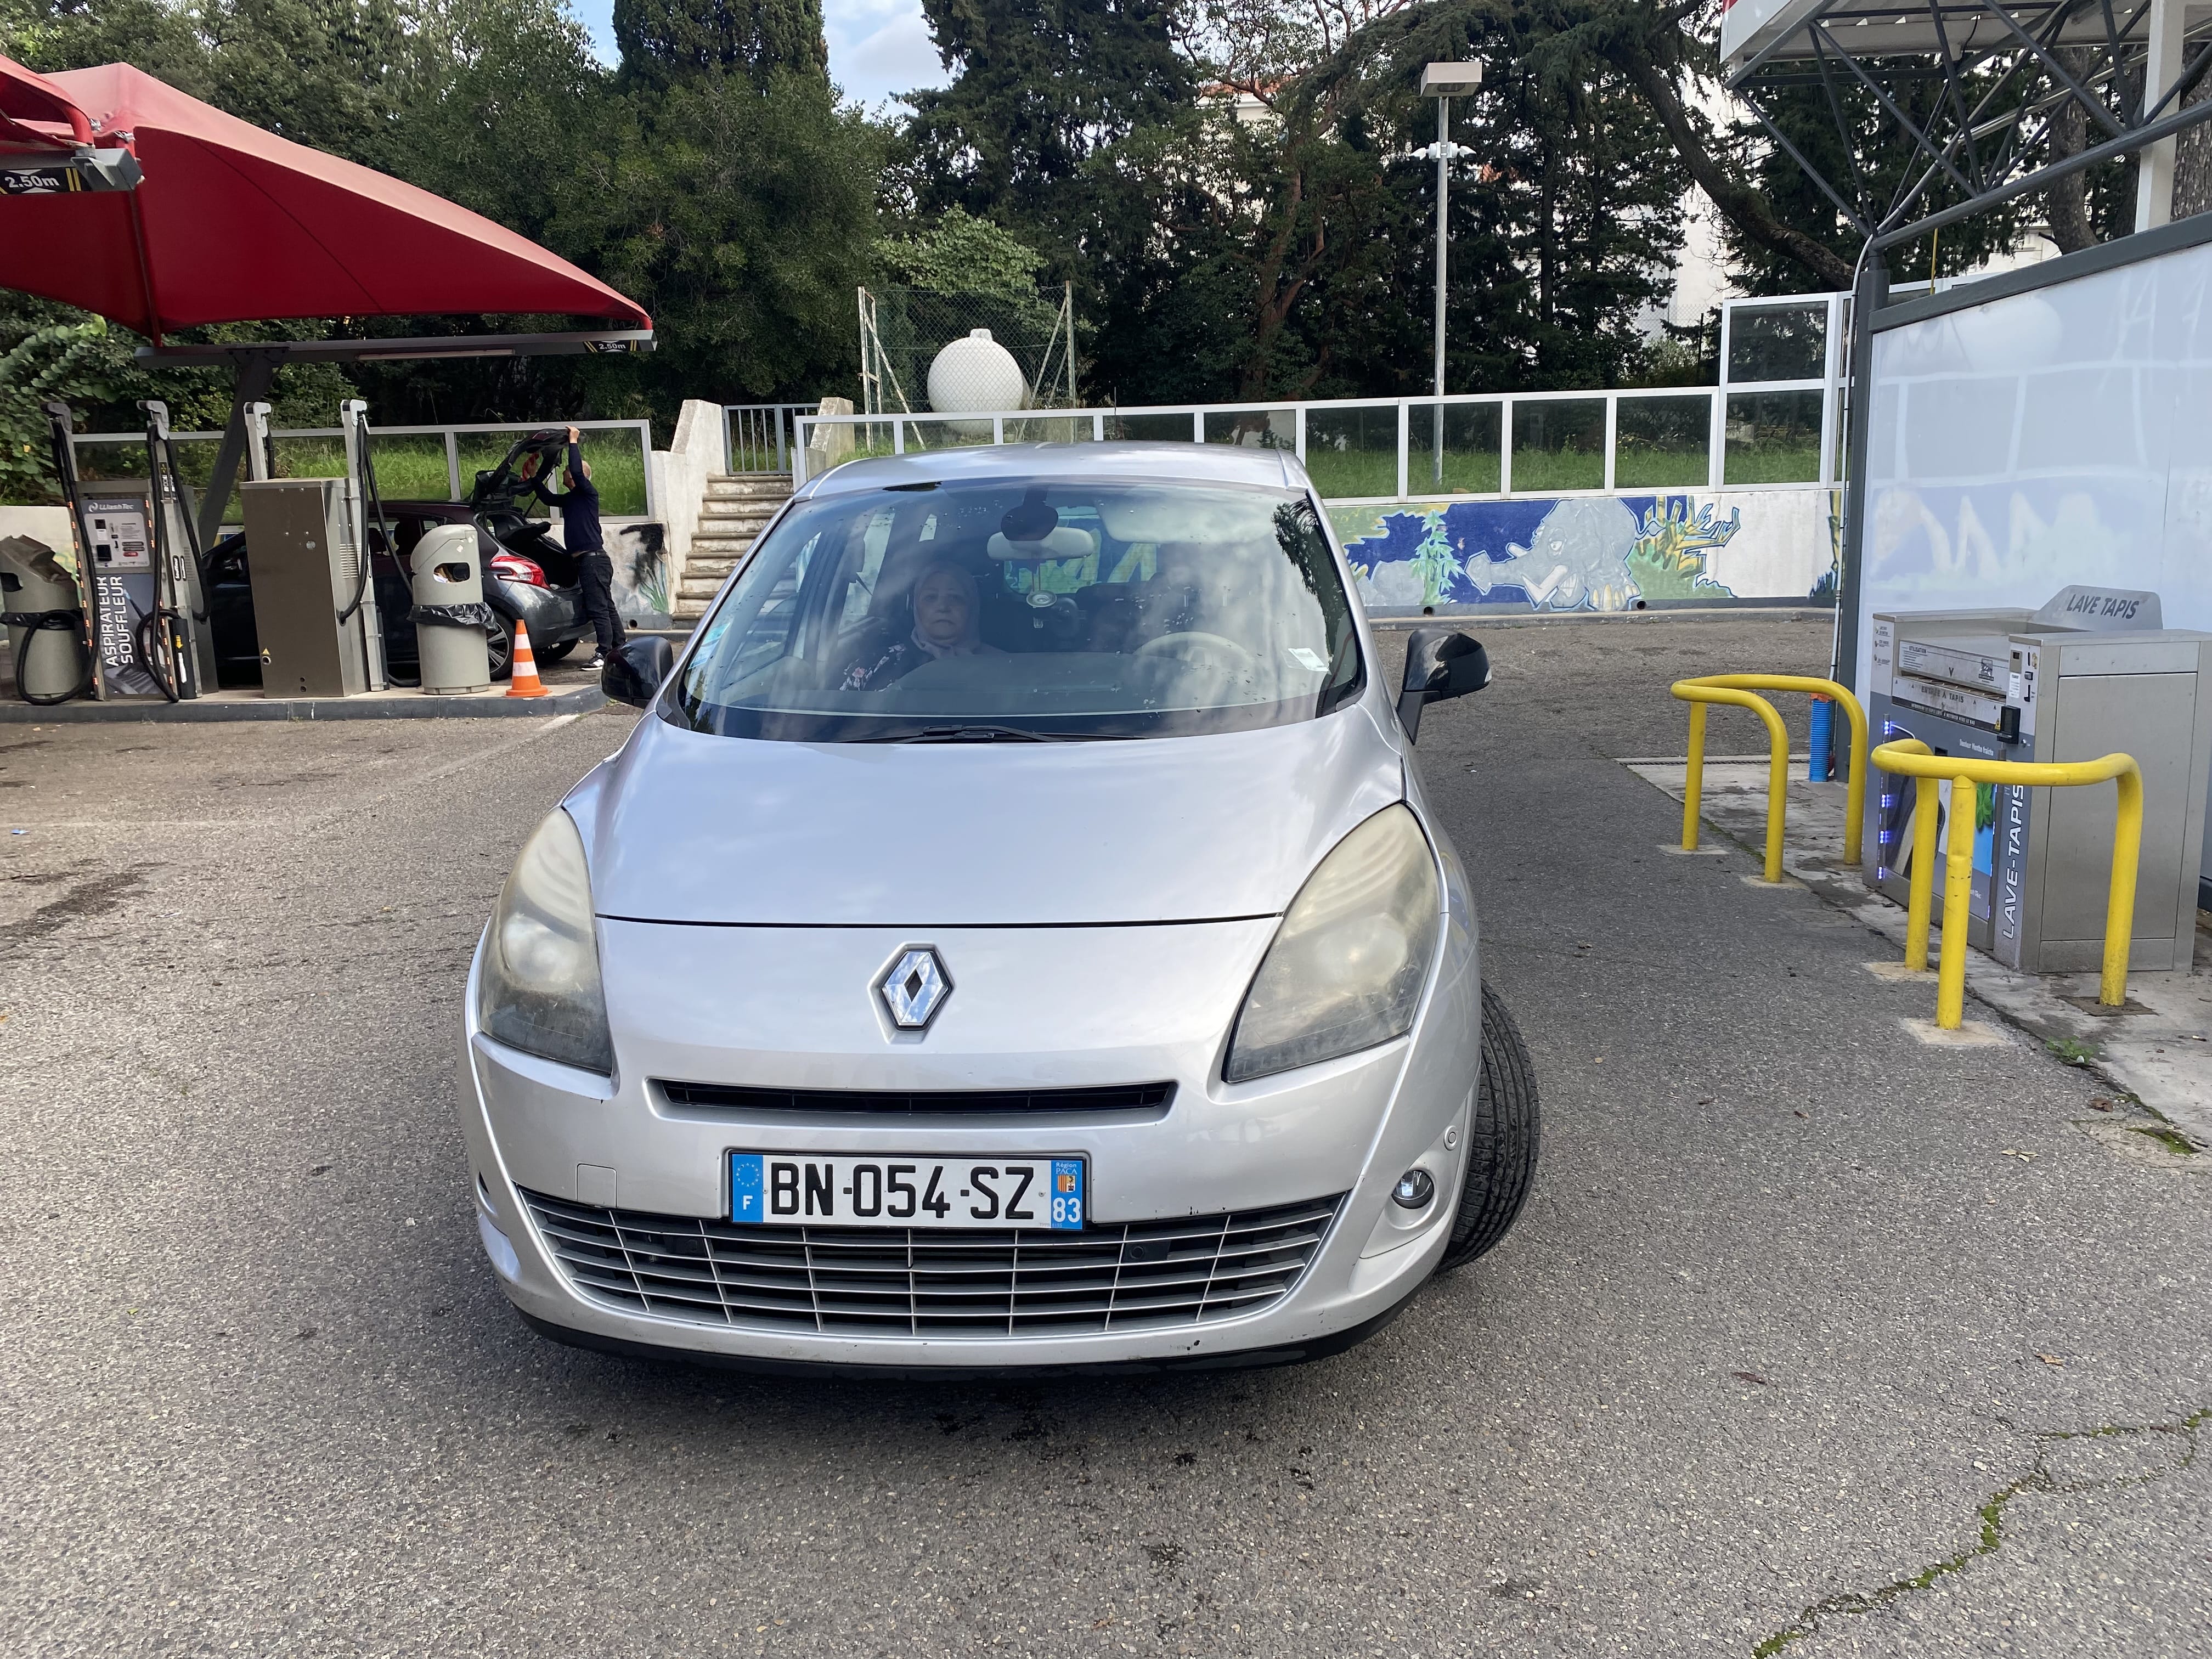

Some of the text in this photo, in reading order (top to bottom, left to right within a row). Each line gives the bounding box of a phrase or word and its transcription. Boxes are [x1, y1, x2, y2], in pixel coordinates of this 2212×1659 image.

[4, 175, 60, 188] 2.50m
[2066, 594, 2140, 619] LAVE TAPIS
[96, 576, 119, 667] ASPIRATEUR
[110, 576, 133, 664] SOUFFLEUR
[1949, 693, 1964, 703] TAPIS
[2002, 785, 2024, 940] LAVE-TAPIS
[743, 1195, 753, 1210] F
[771, 1162, 1034, 1220] BN-054-SZ
[1053, 1197, 1081, 1223] 83
